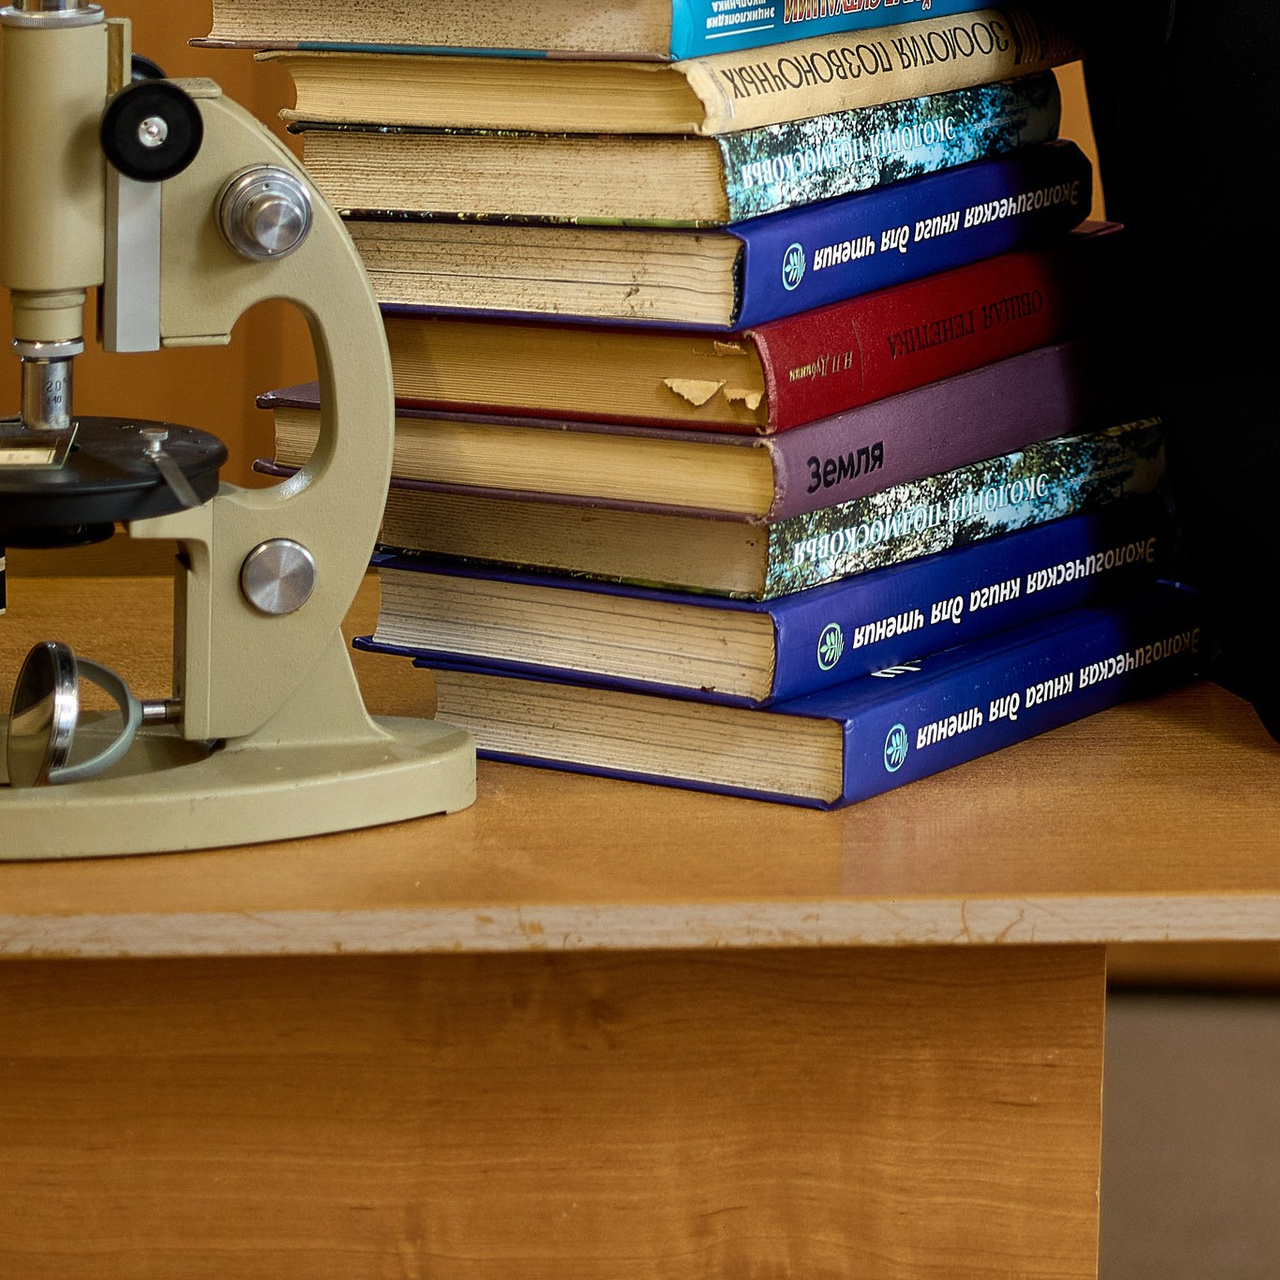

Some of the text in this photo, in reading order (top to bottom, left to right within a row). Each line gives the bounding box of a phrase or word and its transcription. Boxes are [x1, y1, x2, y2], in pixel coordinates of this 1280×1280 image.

[706, 7, 775, 29] ЭНЦИКЛОПЕДИЯ
[721, 22, 1009, 99] ЗООЛОГИЯ ПОЗВОНОЧНЫХ
[741, 116, 957, 189] ЭКОЛОГИЯ ПОДМОСКОВЬЯ
[812, 180, 1080, 271] Экологическая книга для чтения
[886, 289, 1043, 361] ОБЩАЯ ГЕНЕТИКА
[806, 441, 885, 494] Земля
[792, 473, 1050, 566] ЭКОЛОГИЯ ПОДМОСКОВЬЯ
[853, 537, 1156, 649] Экологическая книга для чтения
[916, 627, 1200, 749] Экологическая книга для чтения
